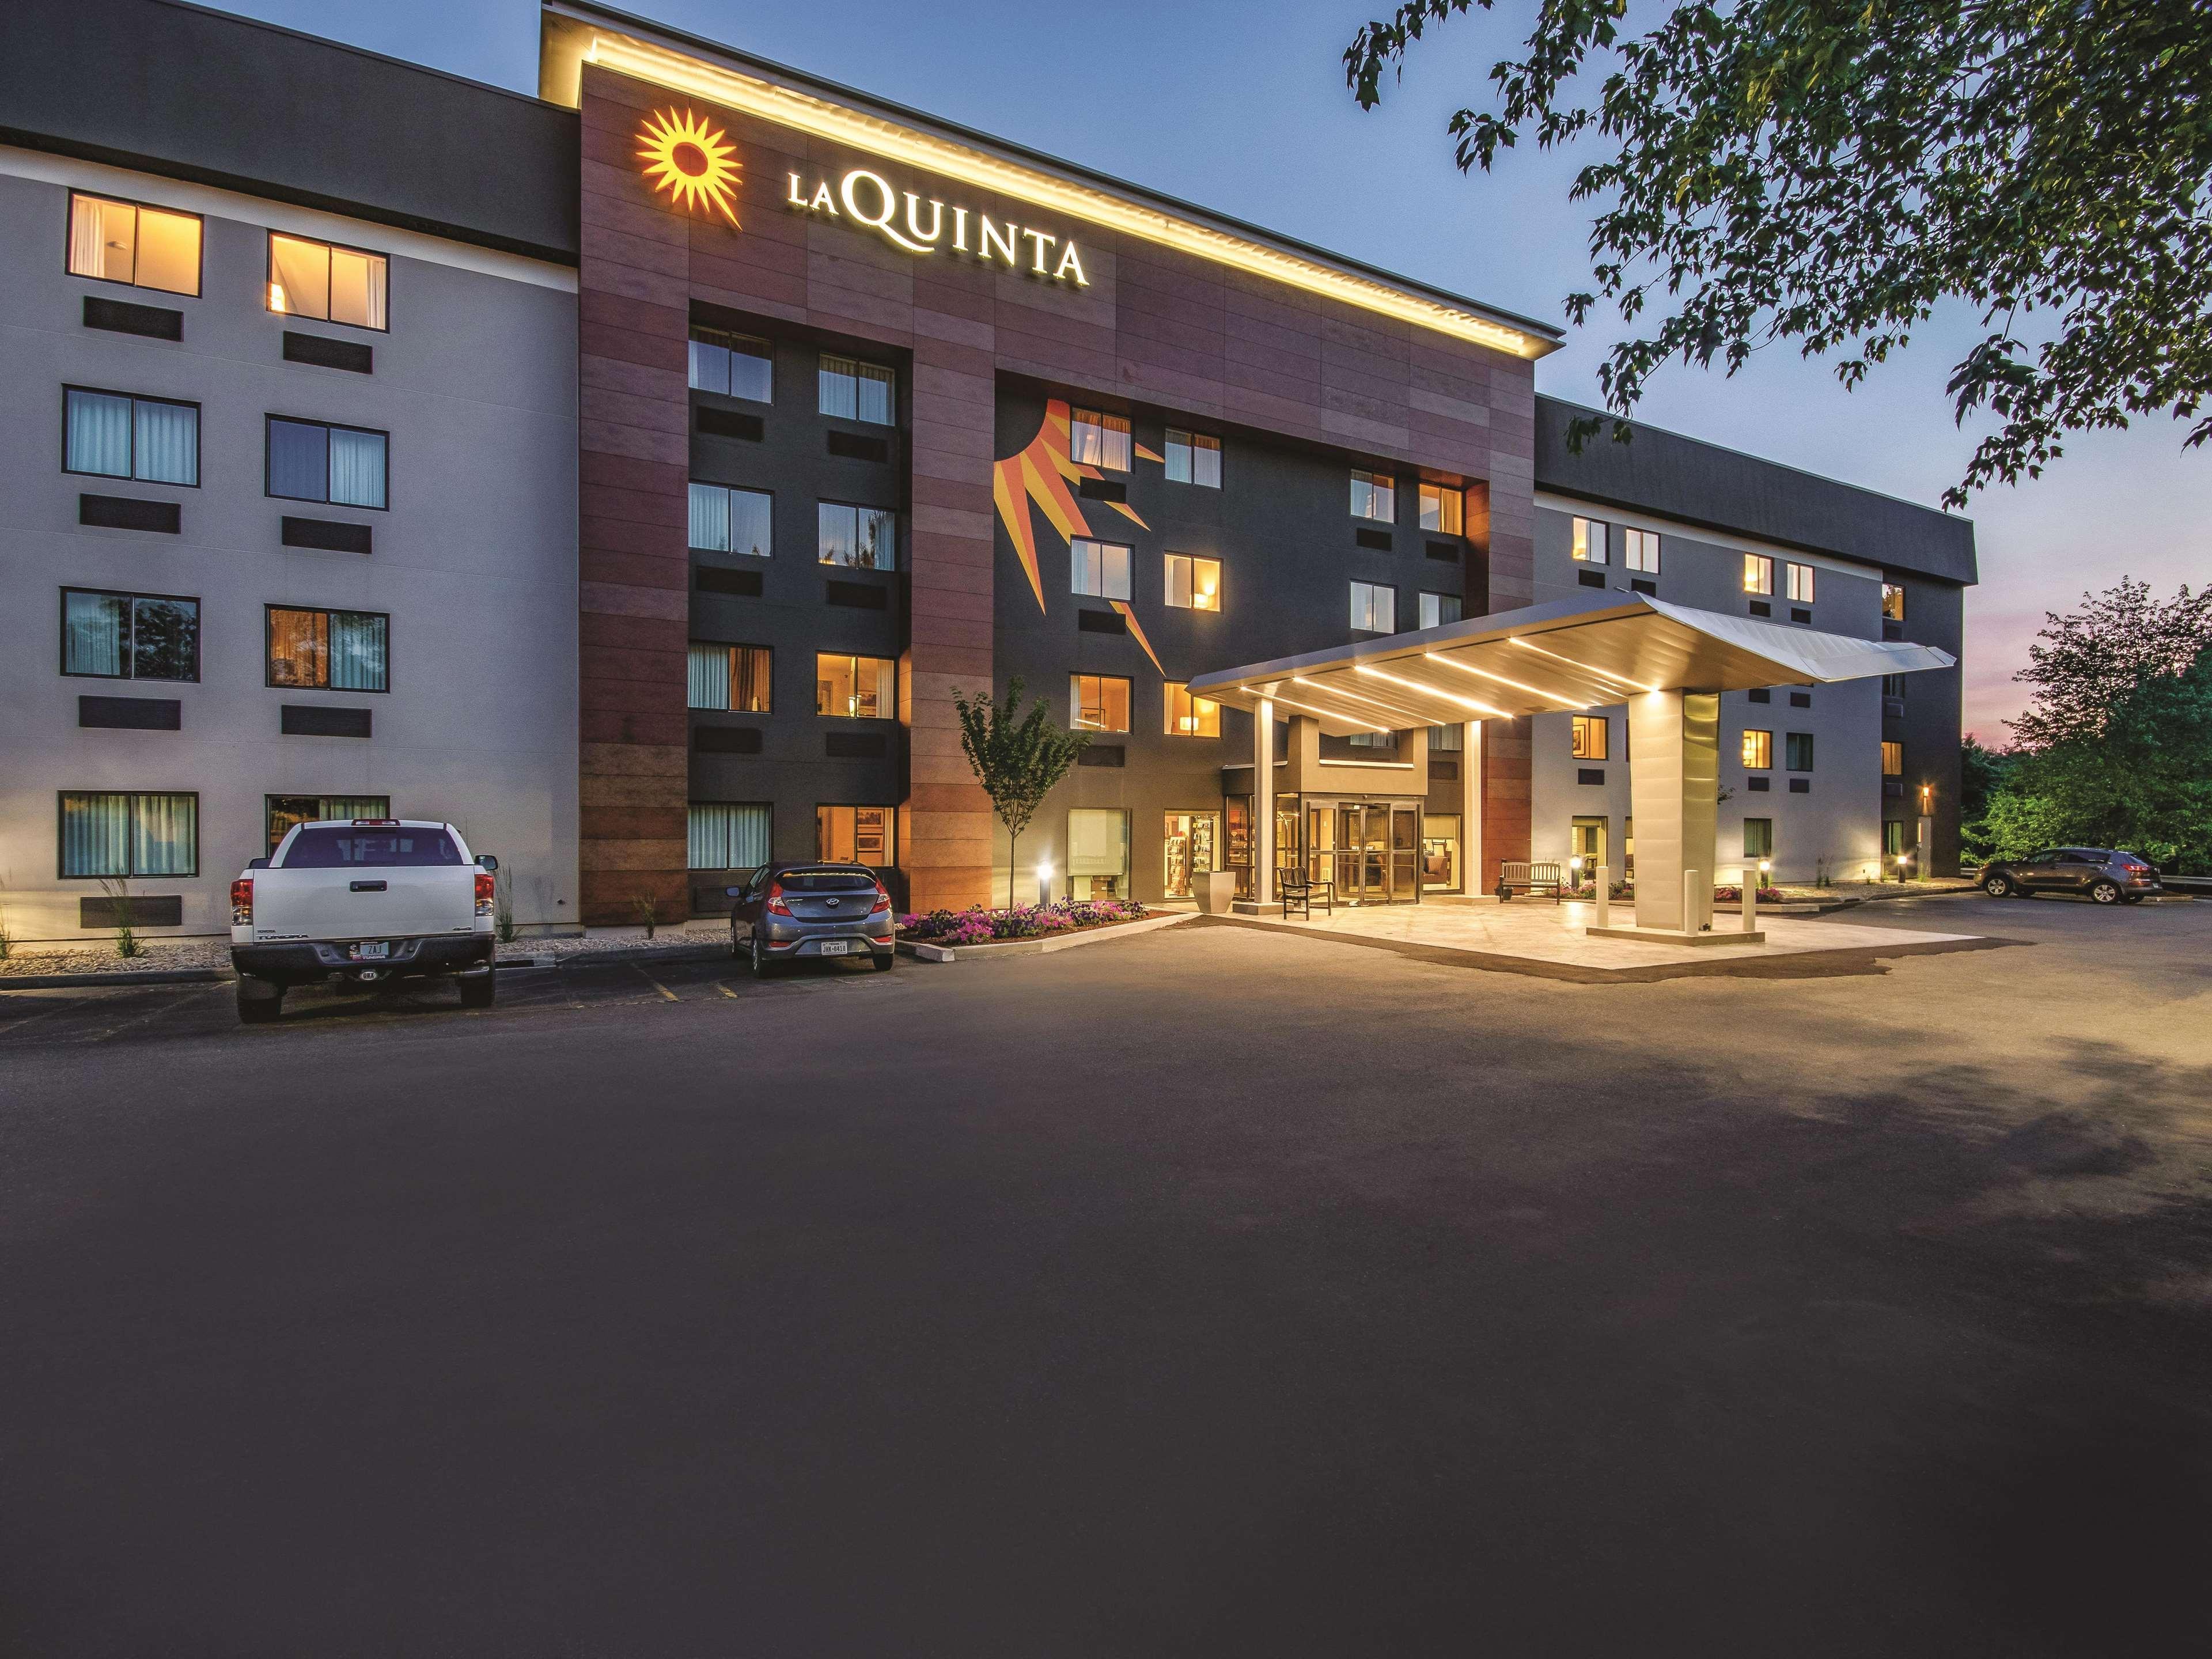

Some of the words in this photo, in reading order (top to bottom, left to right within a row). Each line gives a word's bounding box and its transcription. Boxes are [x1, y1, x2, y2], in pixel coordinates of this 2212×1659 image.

[787, 172, 839, 216] LA
[840, 169, 1090, 286] QUINTA
[368, 945, 381, 954] ZAJ
